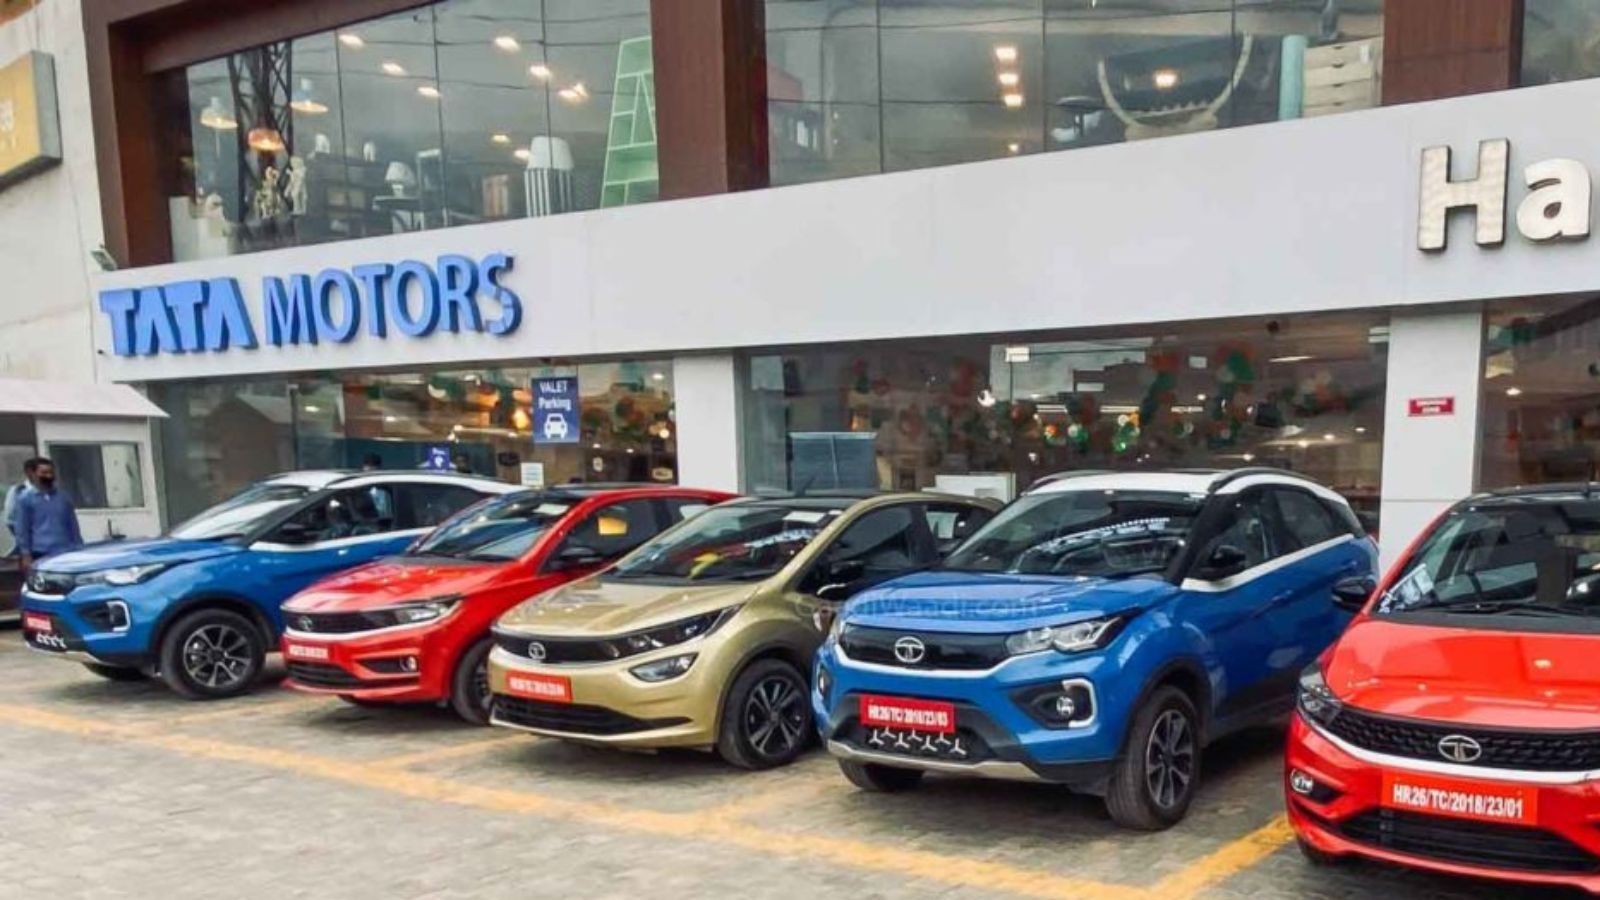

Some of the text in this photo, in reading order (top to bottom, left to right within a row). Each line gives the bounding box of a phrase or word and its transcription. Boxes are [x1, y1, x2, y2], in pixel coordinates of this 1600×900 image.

[1417, 138, 1592, 251] Ha
[100, 254, 522, 357] TATA MOTORS
[538, 397, 572, 411] Parking
[540, 380, 568, 393] VALET
[1392, 783, 1523, 819] HR26/TC/2018/23/01
